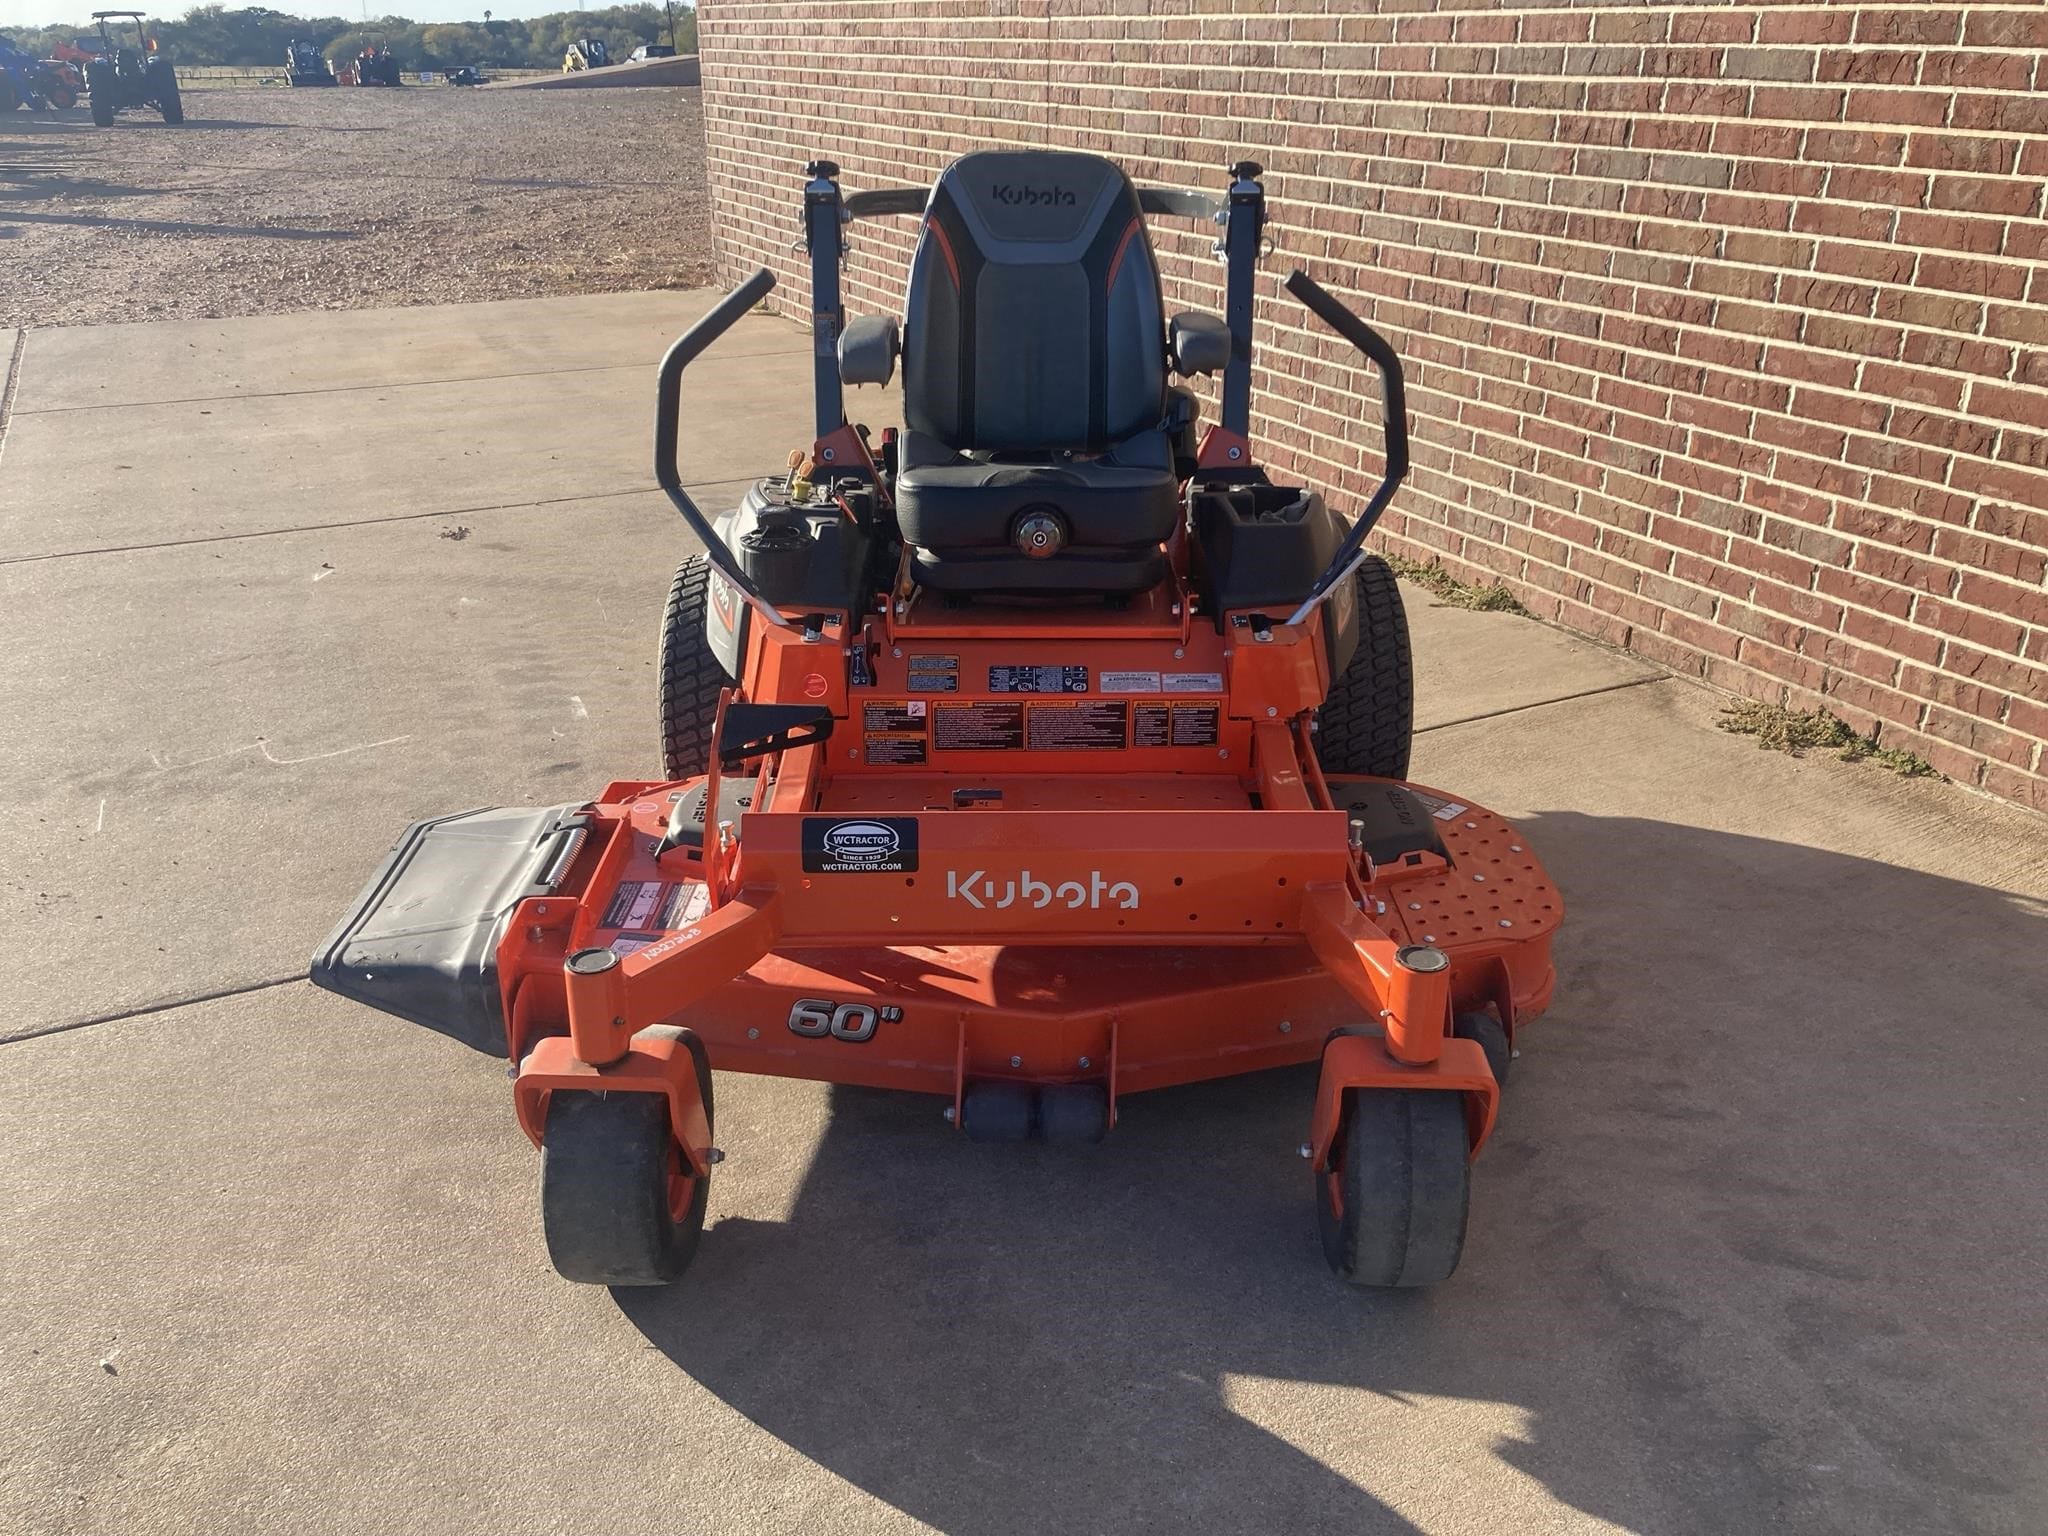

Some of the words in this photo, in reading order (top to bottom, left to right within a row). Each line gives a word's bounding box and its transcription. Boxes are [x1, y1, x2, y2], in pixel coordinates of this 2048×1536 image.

[992, 184, 1076, 205] Kubota
[833, 835, 890, 845] WCTRACTOR
[822, 863, 902, 871] WCTRACTOR.COM
[947, 870, 1139, 909] Kubota
